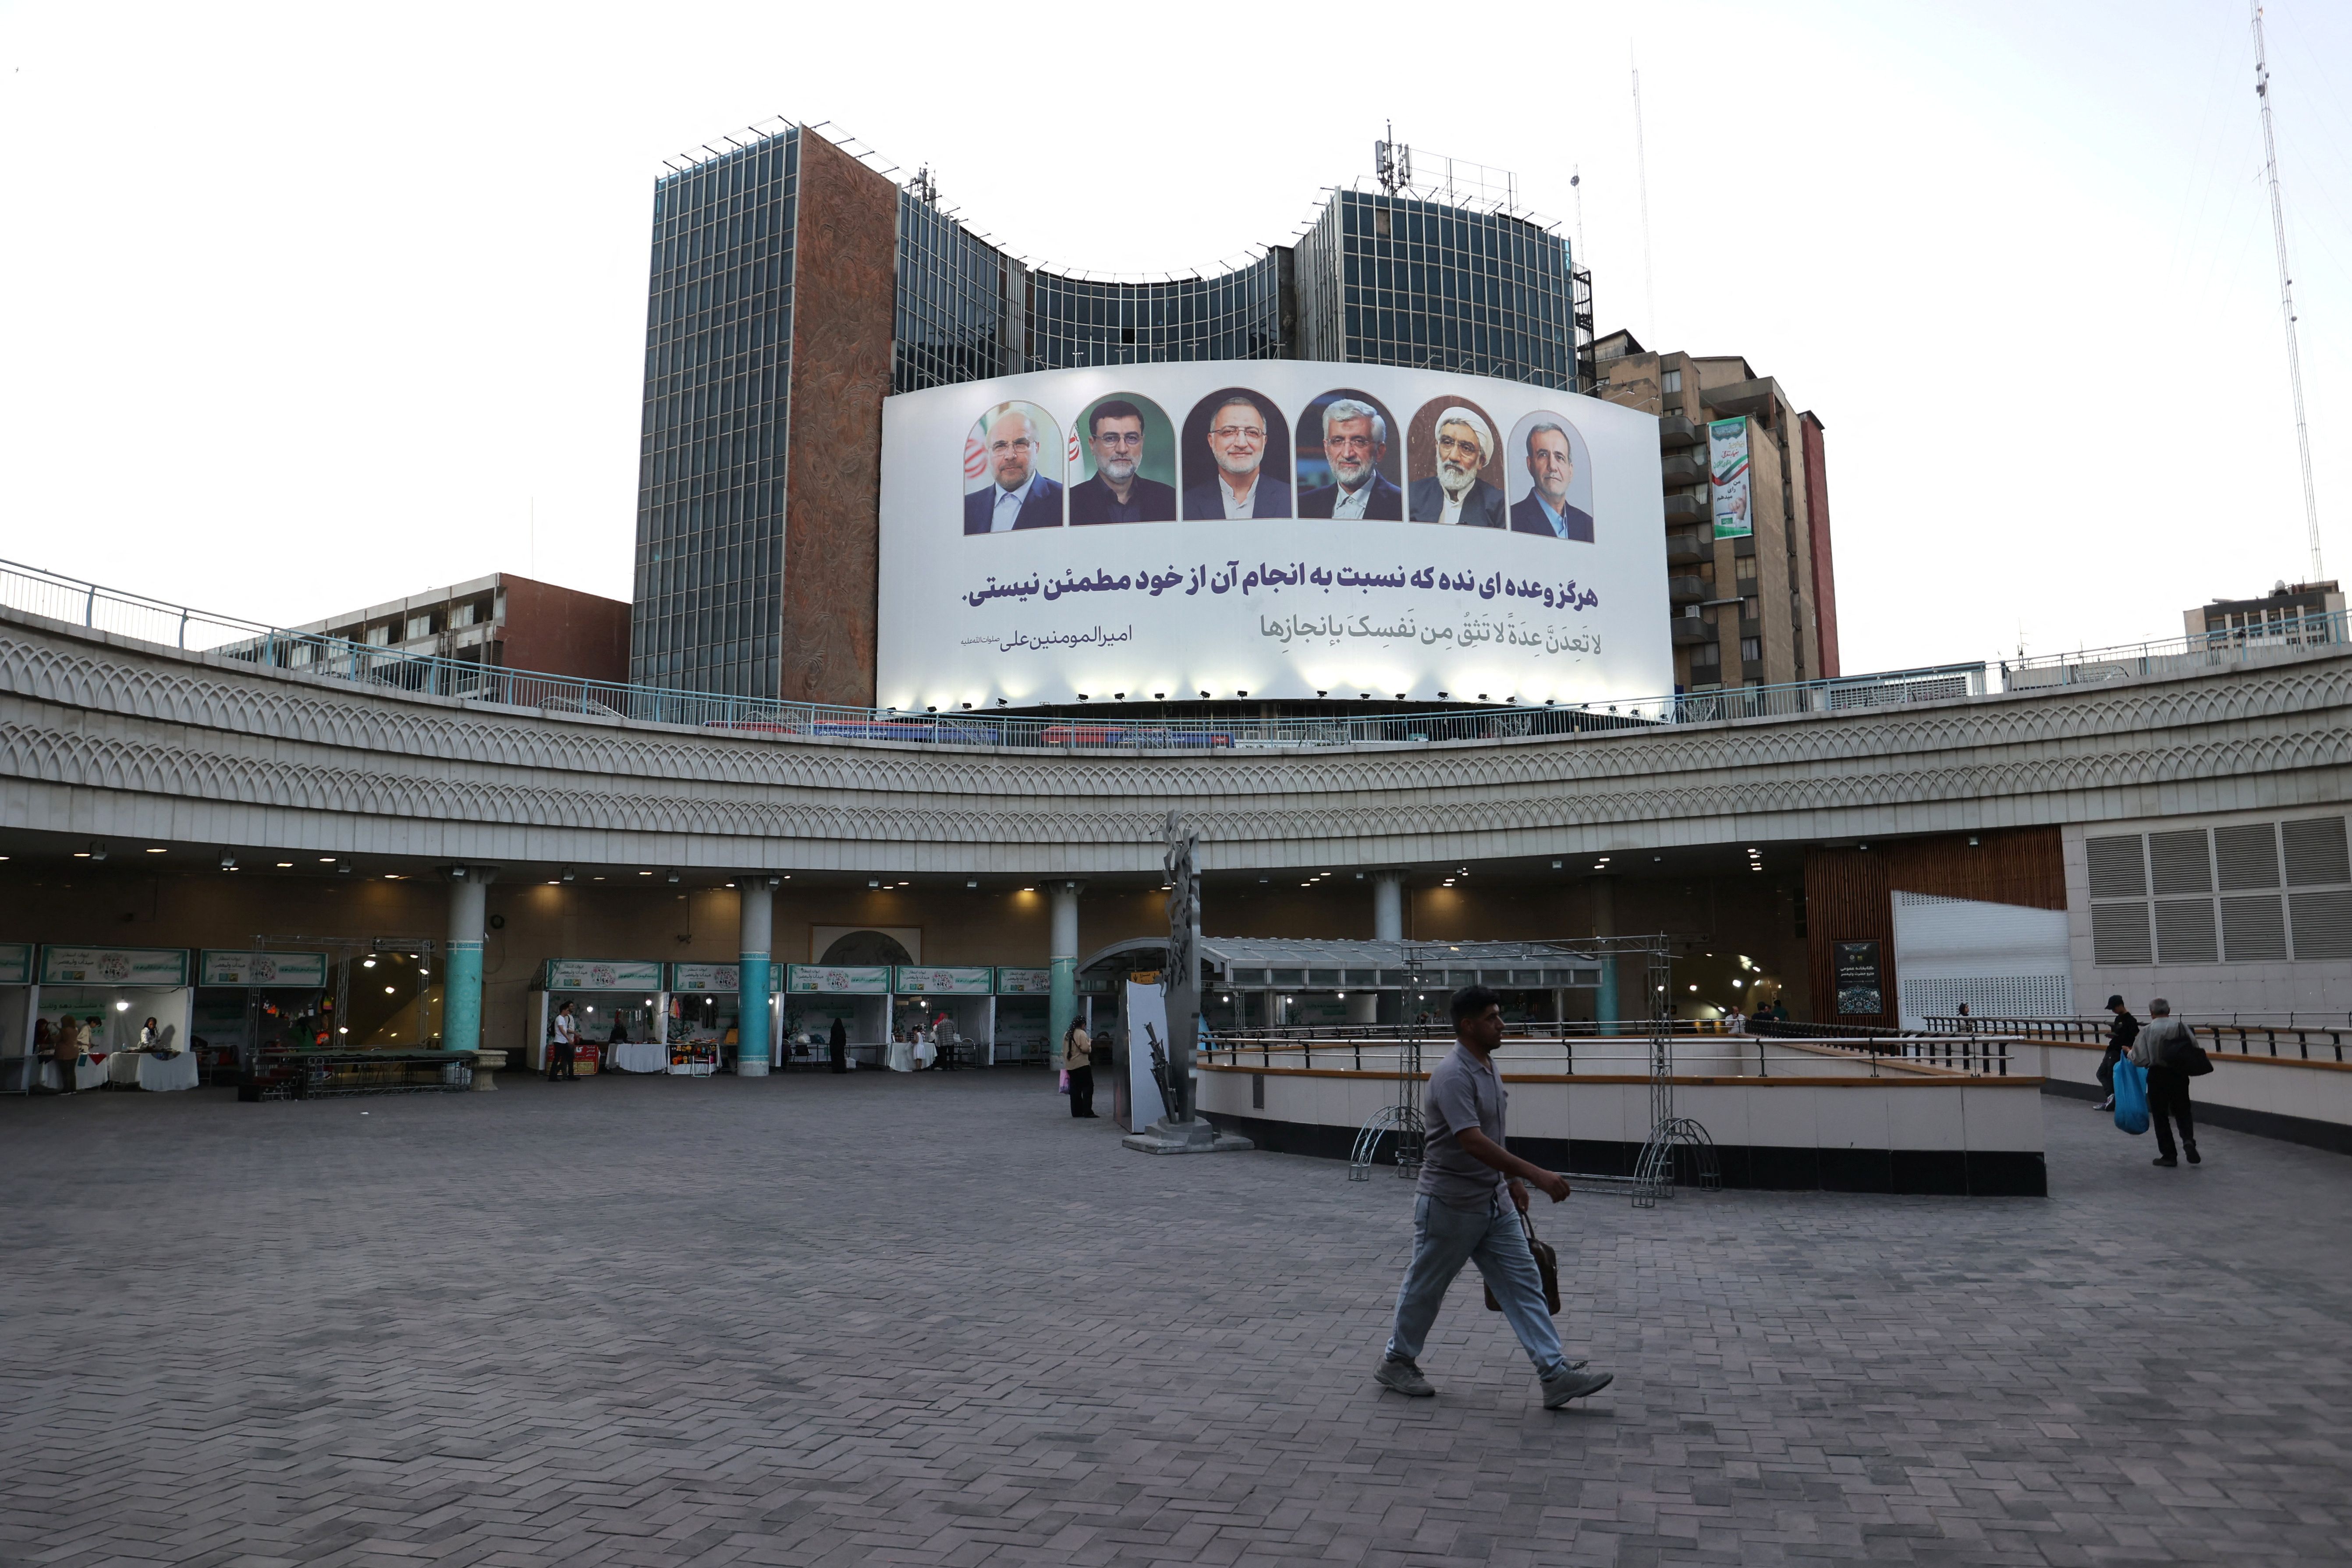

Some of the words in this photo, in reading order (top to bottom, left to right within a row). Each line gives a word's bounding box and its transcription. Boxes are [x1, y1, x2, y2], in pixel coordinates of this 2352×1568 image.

[961, 571, 1039, 607] نیستی.
[1043, 568, 1131, 601] مطمئن
[1135, 564, 1184, 596] خود
[1185, 564, 1206, 596] از
[1211, 560, 1239, 594] آن
[1242, 562, 1305, 596] انجام
[1310, 566, 1332, 594] به
[1337, 565, 1406, 595] نسبت
[1410, 566, 1434, 589] که
[1439, 569, 1475, 591] نده
[1556, 579, 1598, 611] هرگز
[1000, 630, 1029, 652] علی
[1493, 621, 1505, 643] لا
[1591, 634, 1602, 655] لا
